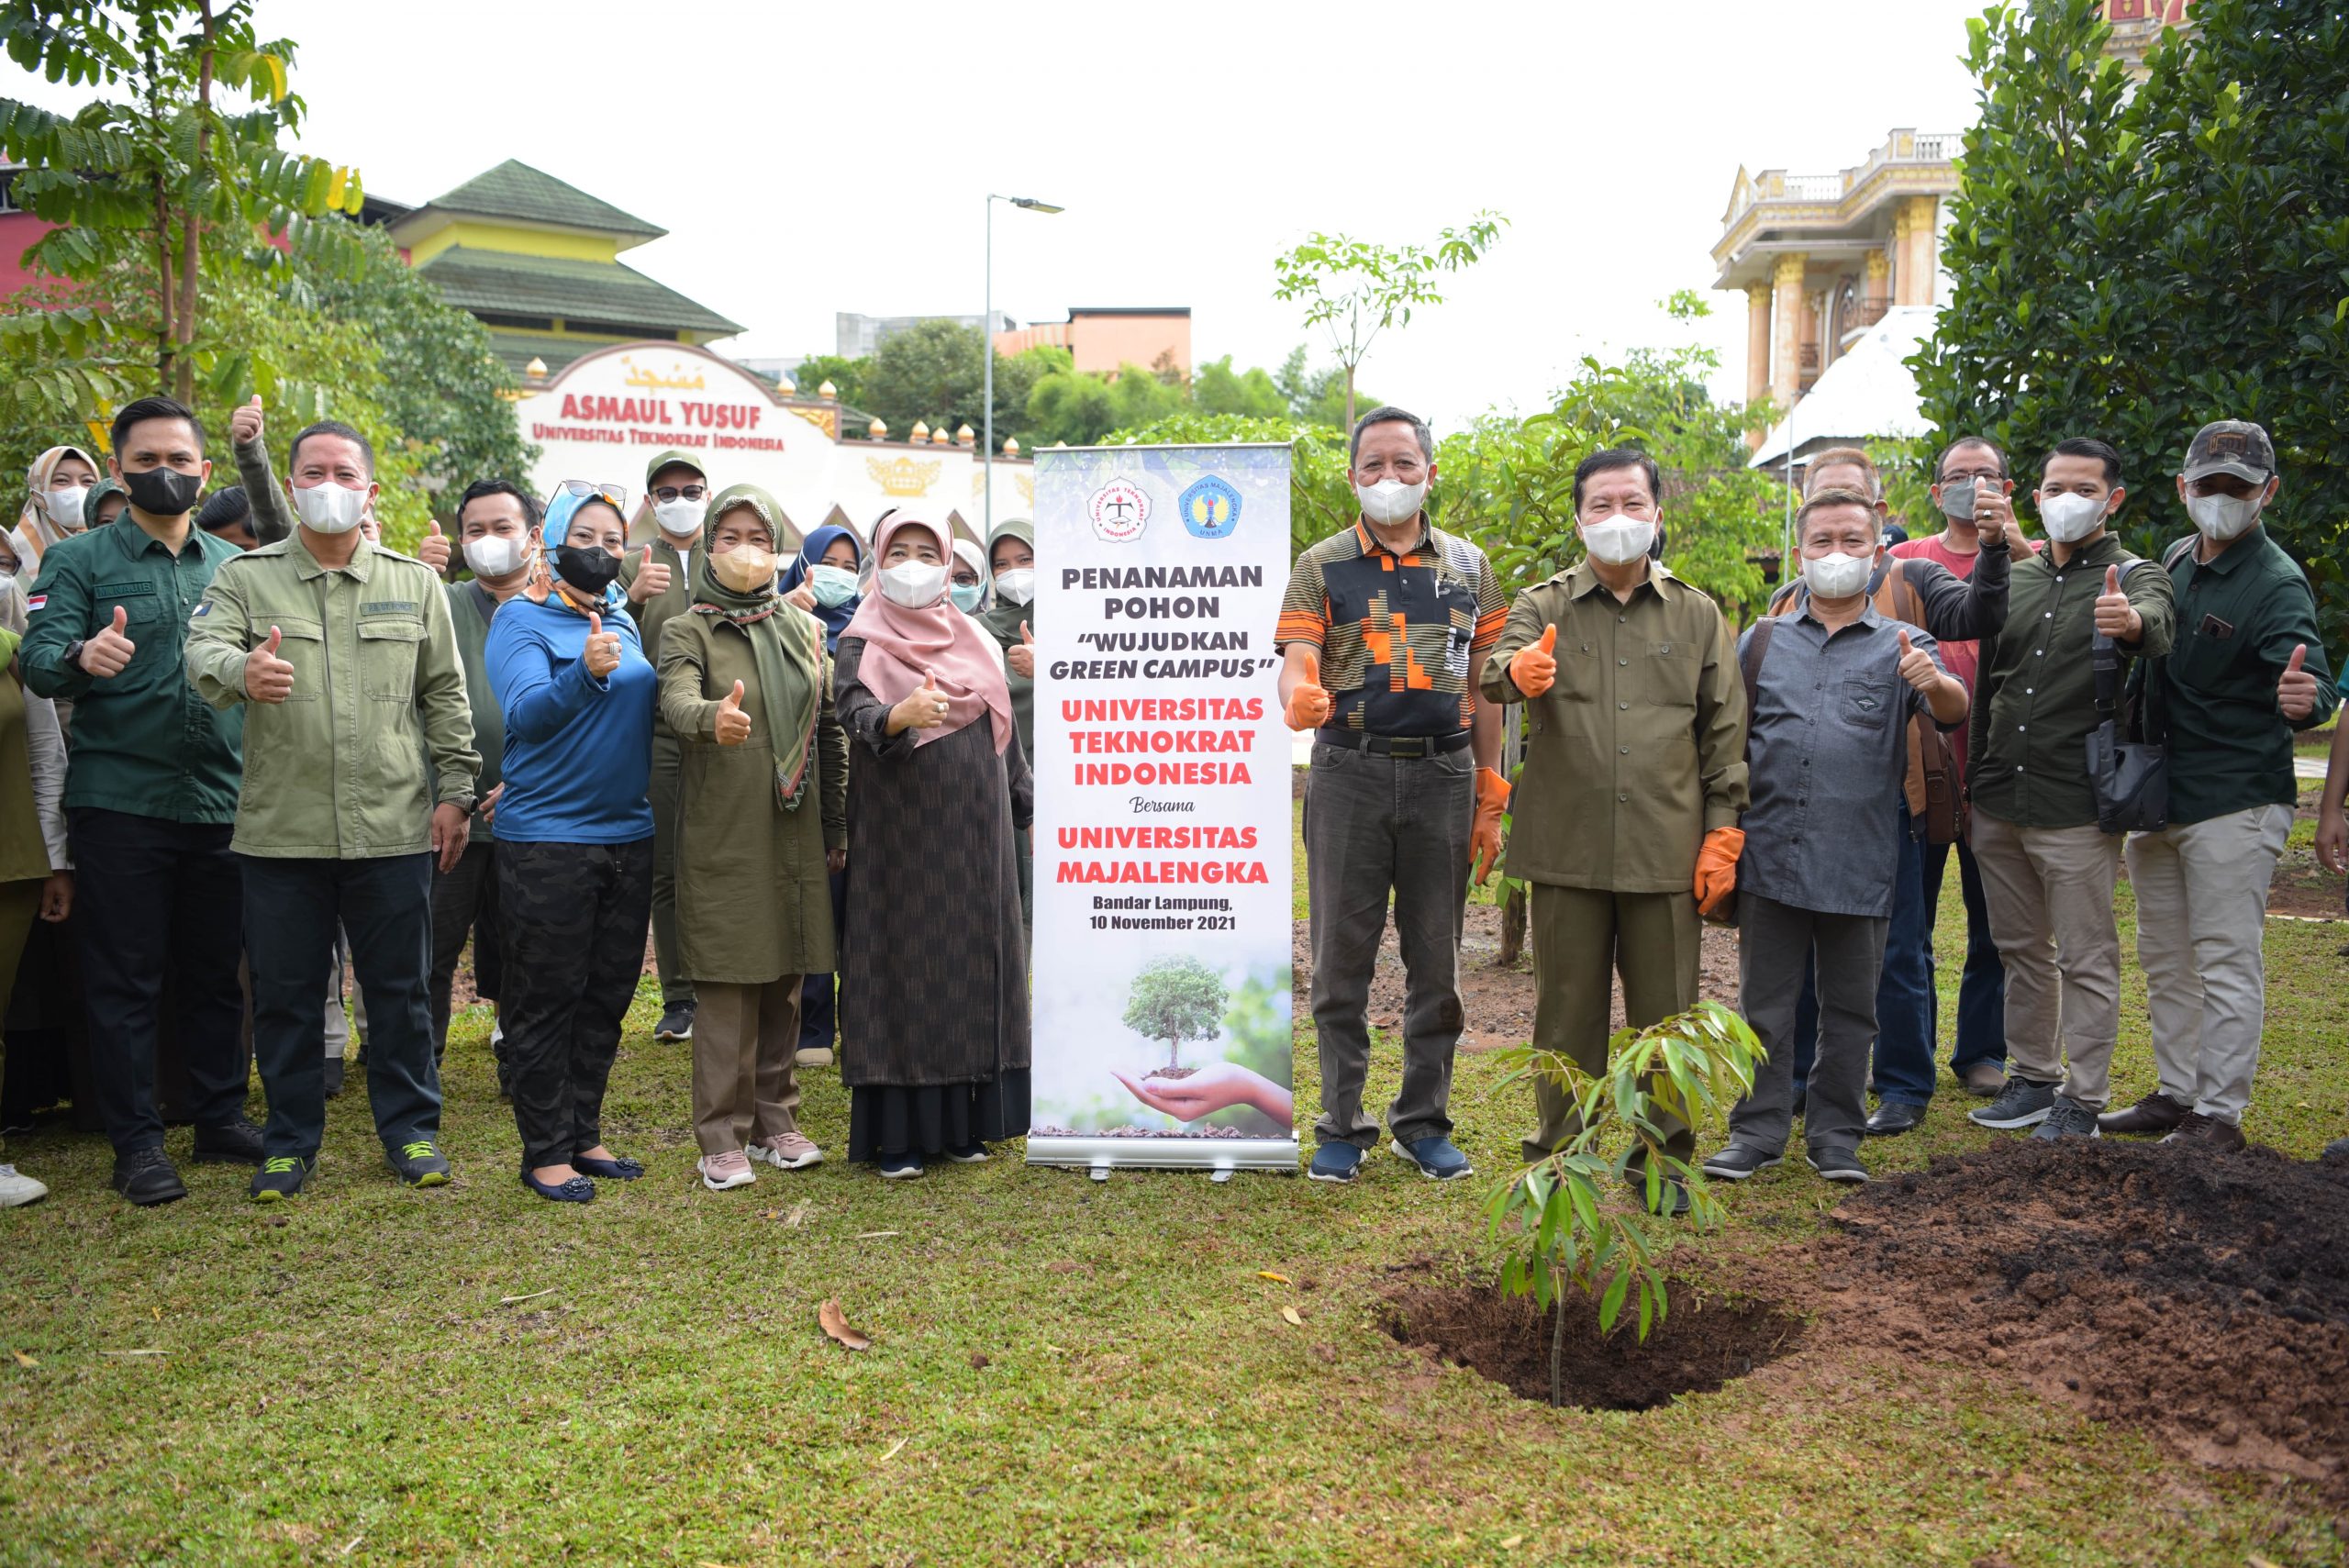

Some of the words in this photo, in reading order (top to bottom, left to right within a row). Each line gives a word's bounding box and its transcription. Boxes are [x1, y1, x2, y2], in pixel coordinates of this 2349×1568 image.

[561, 394, 672, 426] ASMAUL
[680, 401, 761, 429] YUSUF
[1095, 486, 1120, 522] UNIVERSITAS
[1124, 486, 1144, 522] TEKNOKRAT
[1184, 483, 1209, 517] UNIVERSITAS
[1210, 482, 1238, 517] MAJALENGKA
[1103, 526, 1137, 537] INDONESIA
[1199, 528, 1223, 537] UNMA
[1062, 565, 1263, 590] PENANAMAN
[1105, 596, 1219, 619] POHON
[1050, 661, 1138, 680] GREEN
[1062, 698, 1264, 722] UNIVERSITAS
[1069, 730, 1255, 753] TEKNOKRAT
[1074, 762, 1252, 785] INDONESIA
[1129, 796, 1196, 813] Bersama
[1058, 827, 1258, 849] UNIVERSITAS
[1056, 861, 1269, 884] MAJALENGKA
[1093, 895, 1152, 910] Bandar
[1154, 896, 1233, 912] Lampung,
[1089, 916, 1108, 930] 10
[1111, 916, 1194, 930] November
[1197, 916, 1236, 930] 2021
